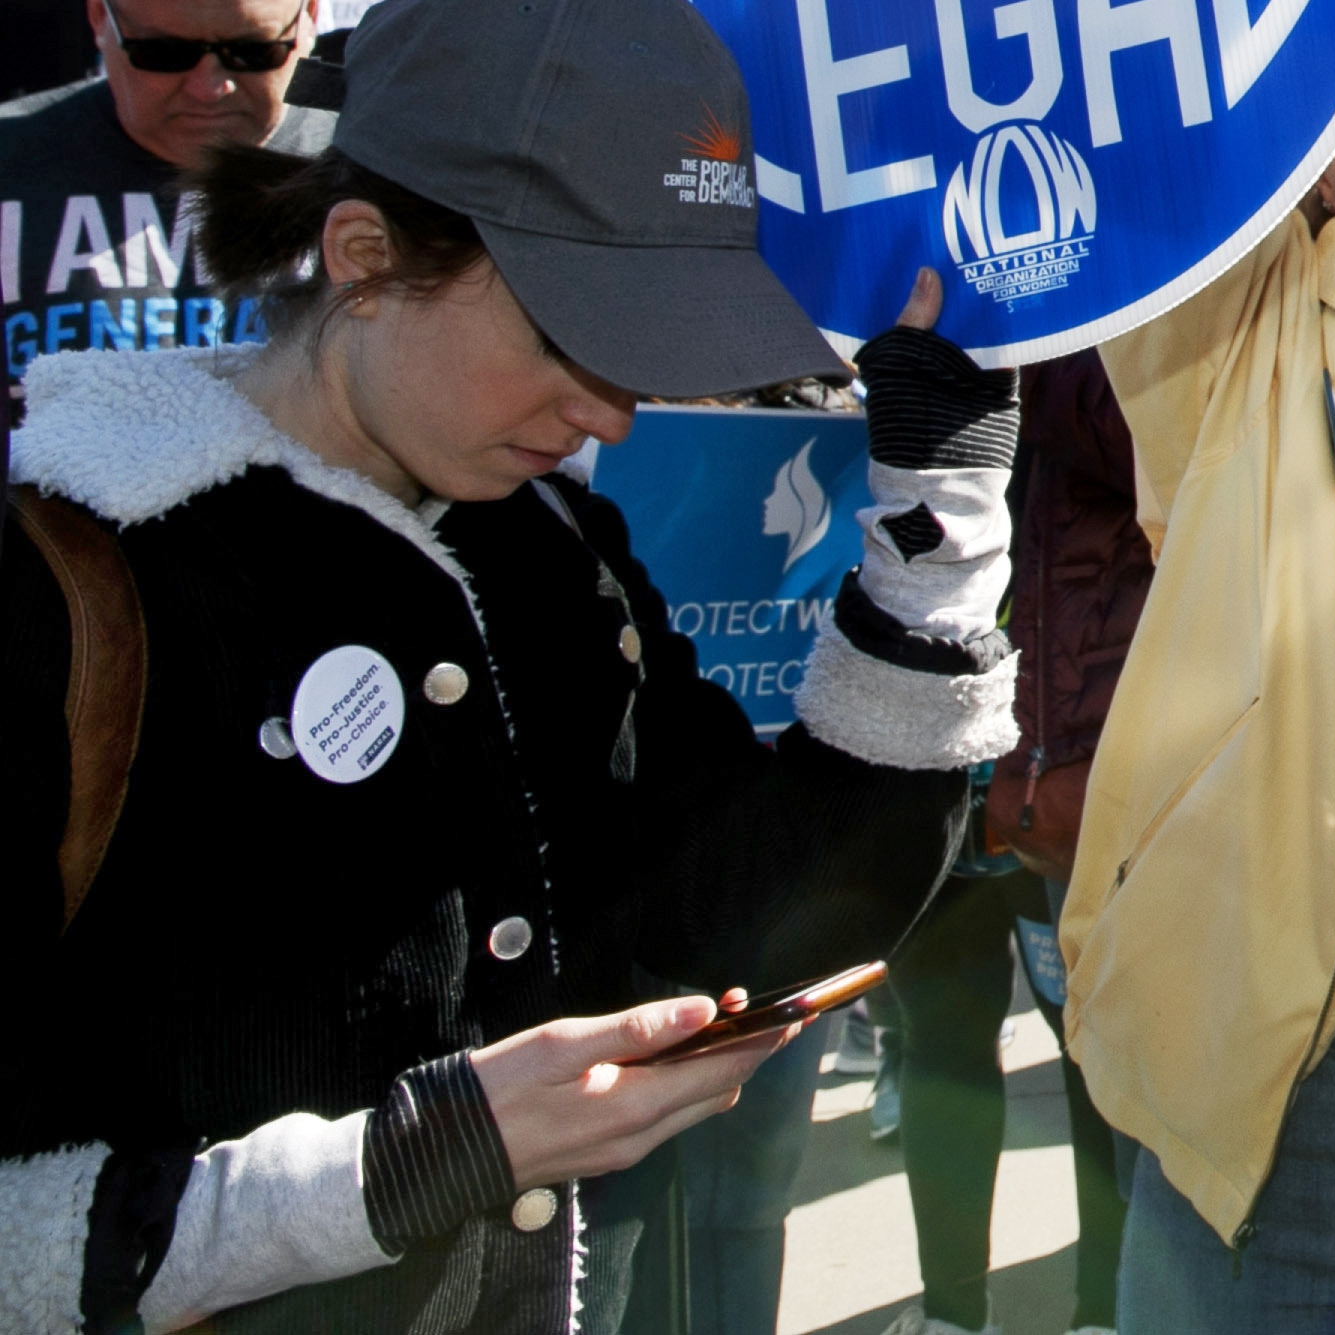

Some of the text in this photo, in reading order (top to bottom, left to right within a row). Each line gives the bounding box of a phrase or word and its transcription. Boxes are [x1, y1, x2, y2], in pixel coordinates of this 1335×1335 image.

[663, 173, 698, 187] CENTER
[681, 158, 698, 172] THE
[679, 189, 697, 202] FOR
[943, 124, 1097, 265] NOW
[0, 190, 215, 304] I AM
[963, 242, 1090, 280] NATIONAL
[975, 259, 1080, 291] ORGANIZATION
[993, 275, 1068, 299] FOR WOMEN
[309, 662, 381, 739] Pro-Freedom.
[318, 682, 384, 752] Pro-Justice.
[327, 698, 390, 766] Pro-Choice.
